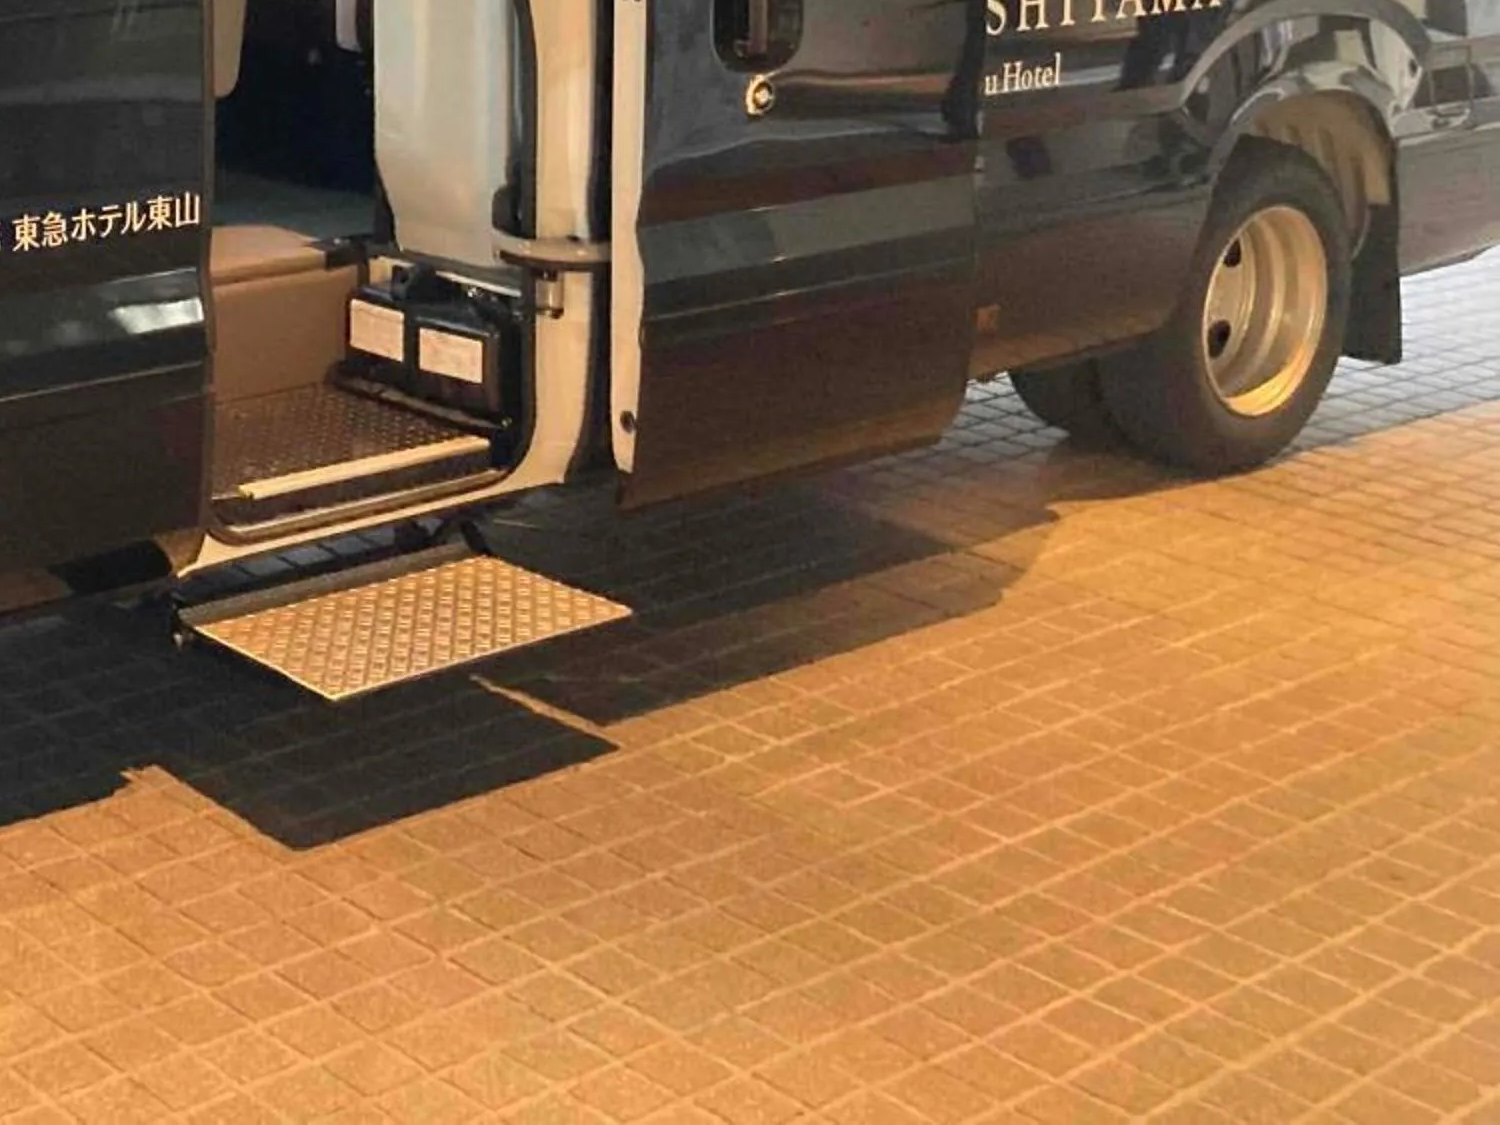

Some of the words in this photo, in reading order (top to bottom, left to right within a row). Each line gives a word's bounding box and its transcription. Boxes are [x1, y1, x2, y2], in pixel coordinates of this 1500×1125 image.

[1002, 51, 1062, 93] Hotel
[12, 191, 200, 252] 東急ホテル東山
